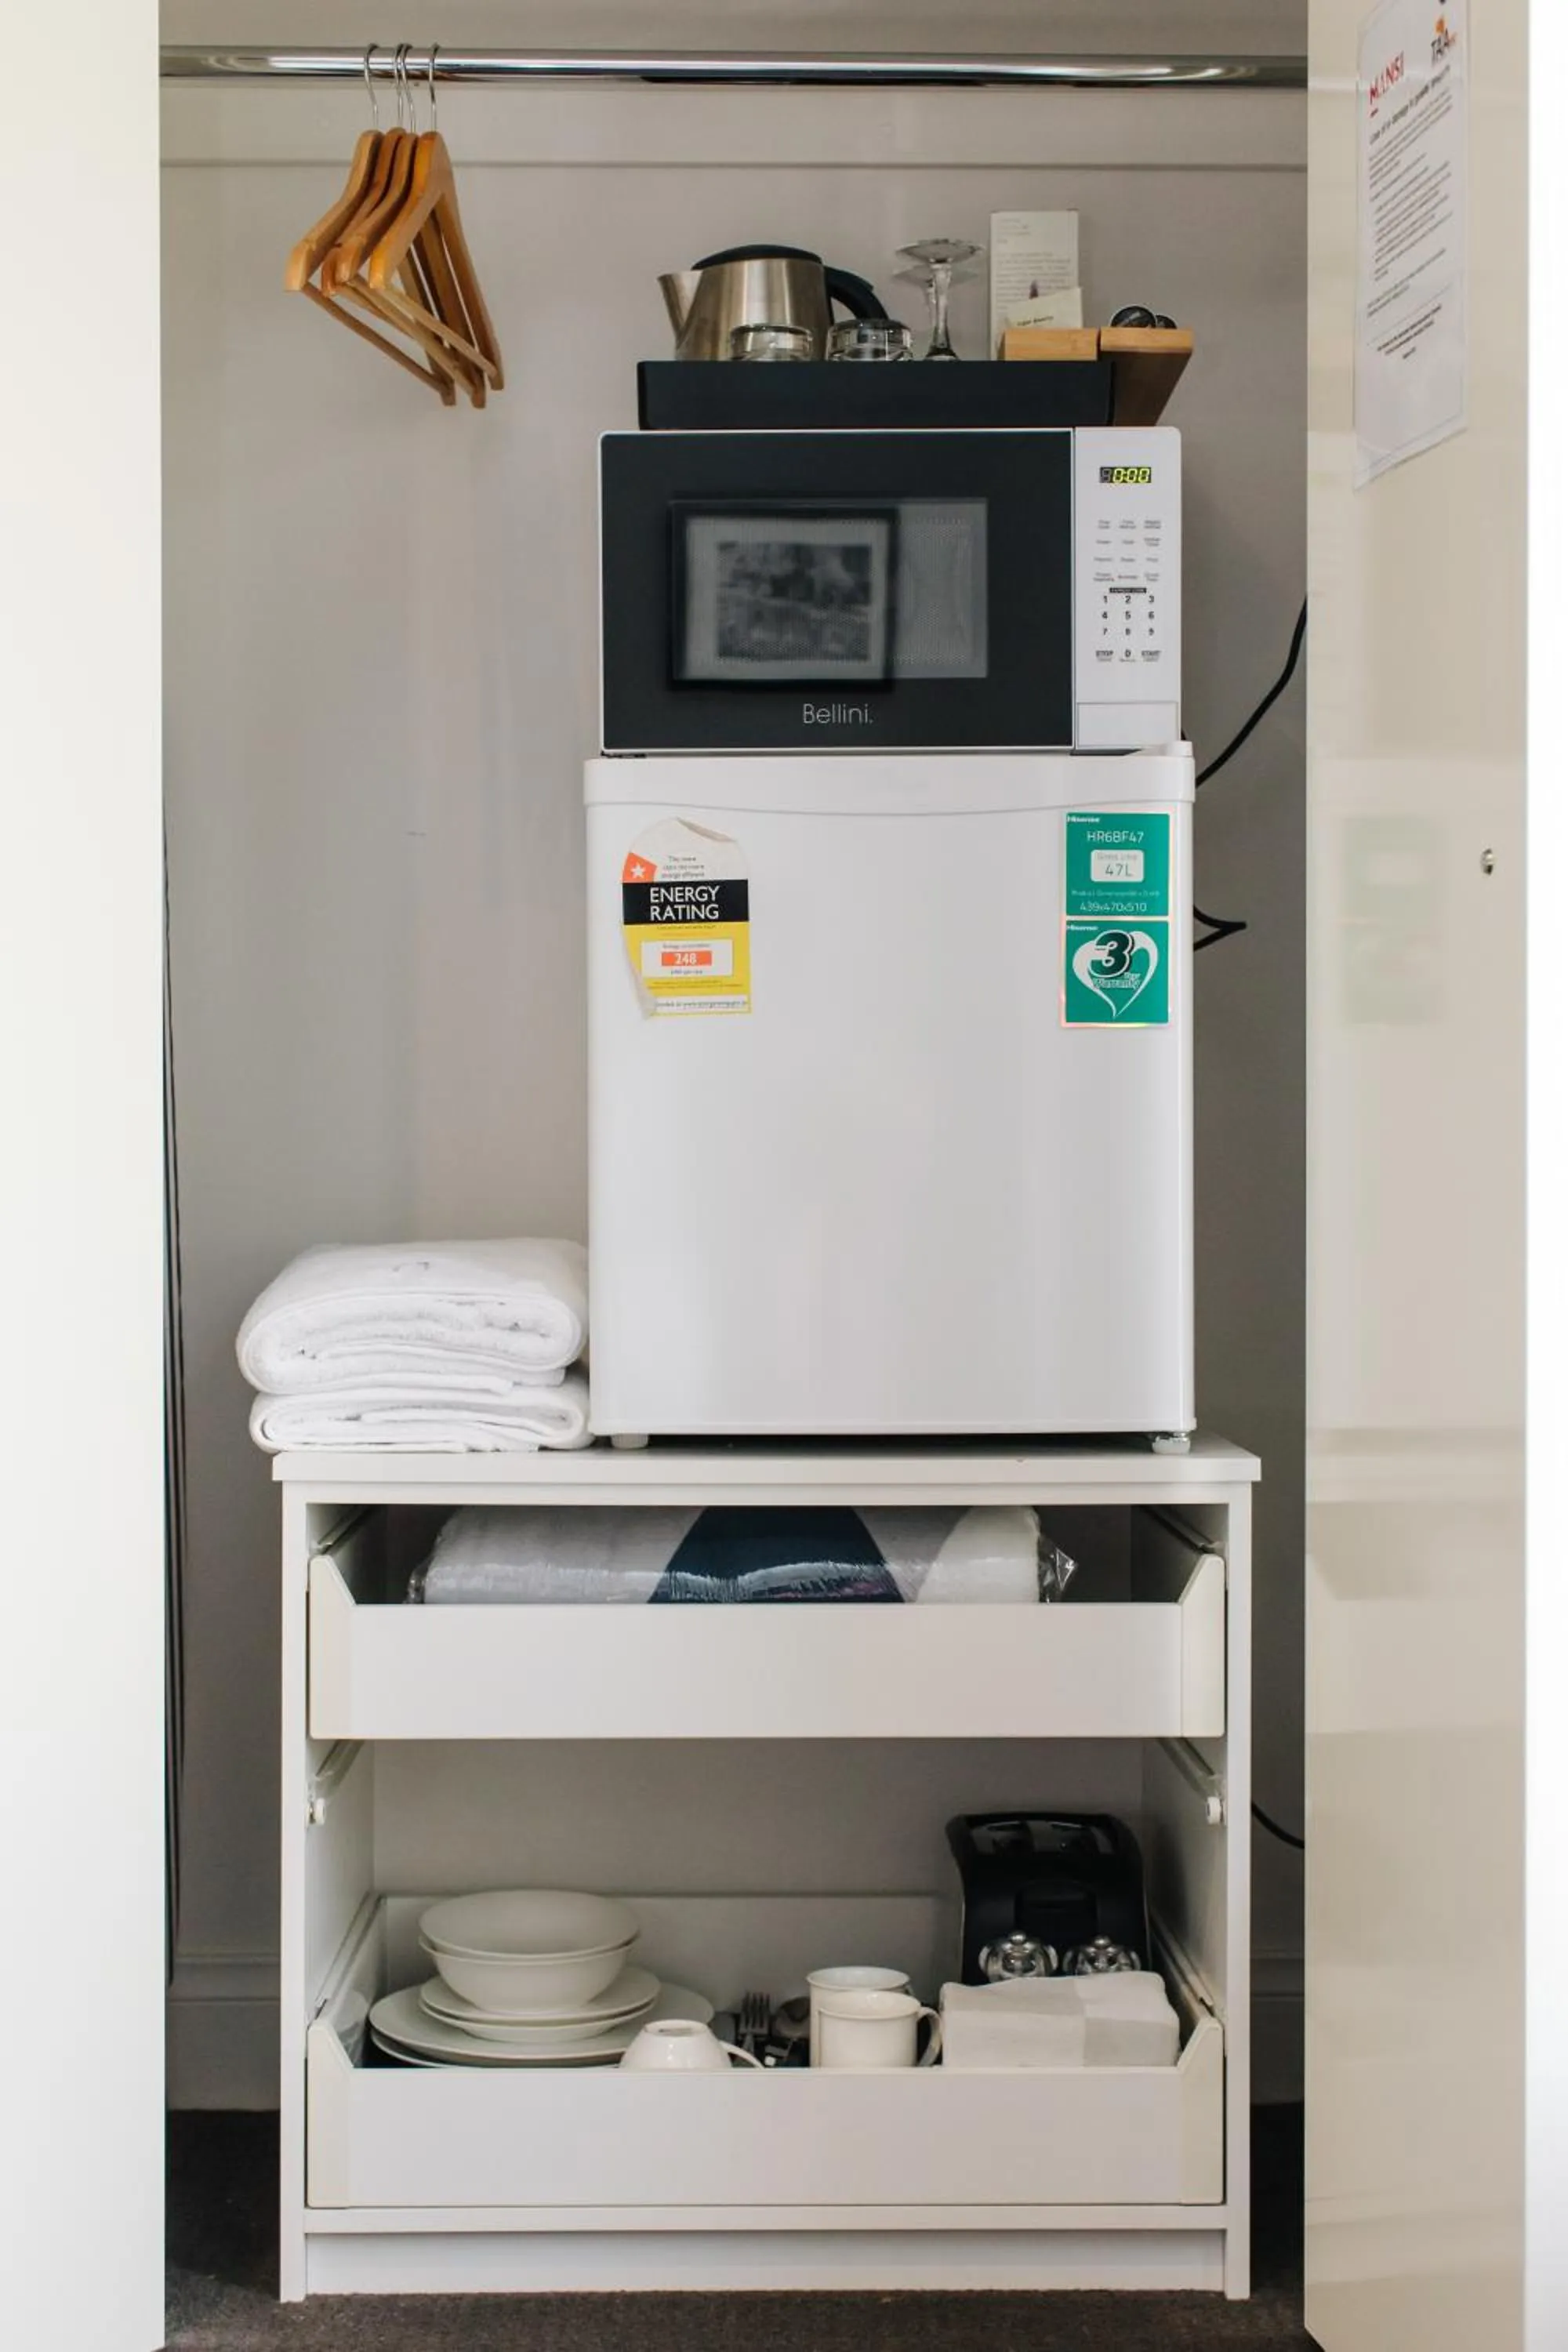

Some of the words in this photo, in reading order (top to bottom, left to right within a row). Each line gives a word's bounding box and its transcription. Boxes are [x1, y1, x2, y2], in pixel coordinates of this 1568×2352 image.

[1102, 595, 1108, 604] 1
[1125, 595, 1131, 604] 2
[1149, 595, 1155, 604] 3
[1102, 611, 1108, 619] 4
[1125, 611, 1131, 619] 5
[1149, 611, 1155, 619] 6
[1102, 627, 1108, 636] 7
[1149, 627, 1155, 636] 9
[650, 886, 720, 903] ENERGY
[650, 904, 720, 921] RATING
[1088, 930, 1134, 978] 3
